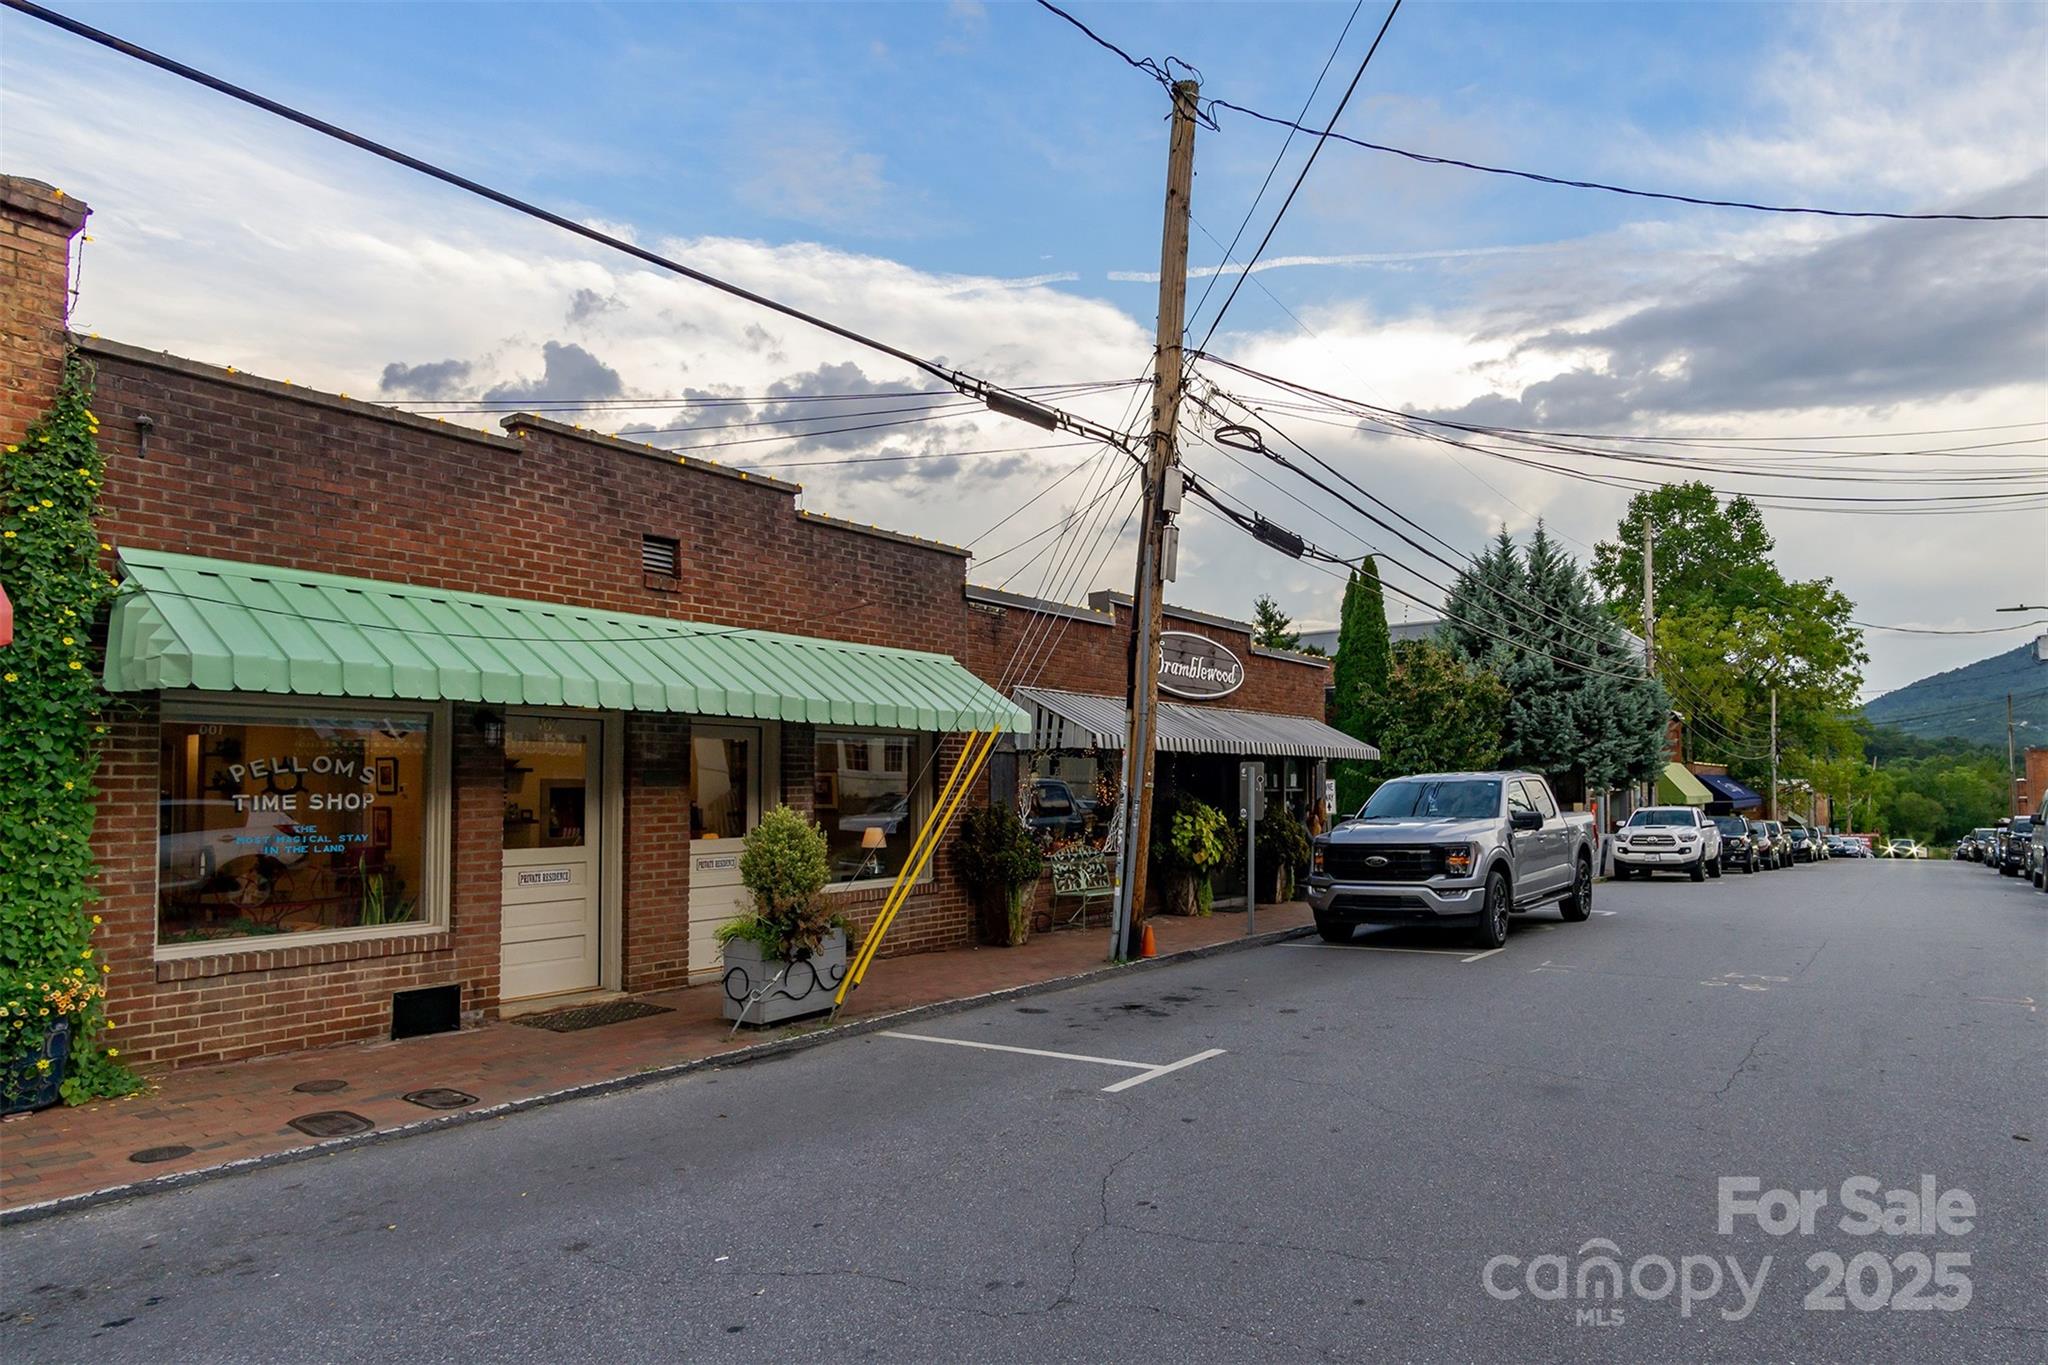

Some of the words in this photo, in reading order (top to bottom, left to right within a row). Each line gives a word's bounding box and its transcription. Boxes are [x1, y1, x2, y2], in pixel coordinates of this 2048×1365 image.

[232, 794, 297, 811] TIME
[309, 793, 375, 810] SHOP
[294, 825, 317, 833] THE
[235, 836, 270, 845] MOST
[276, 835, 331, 844] MAGICAL
[339, 834, 369, 842] STAY
[264, 846, 279, 855] IN
[285, 845, 309, 853] THE
[313, 844, 345, 854] LAND
[520, 873, 541, 884] PRIVATE
[542, 871, 569, 883] RESIDENCE
